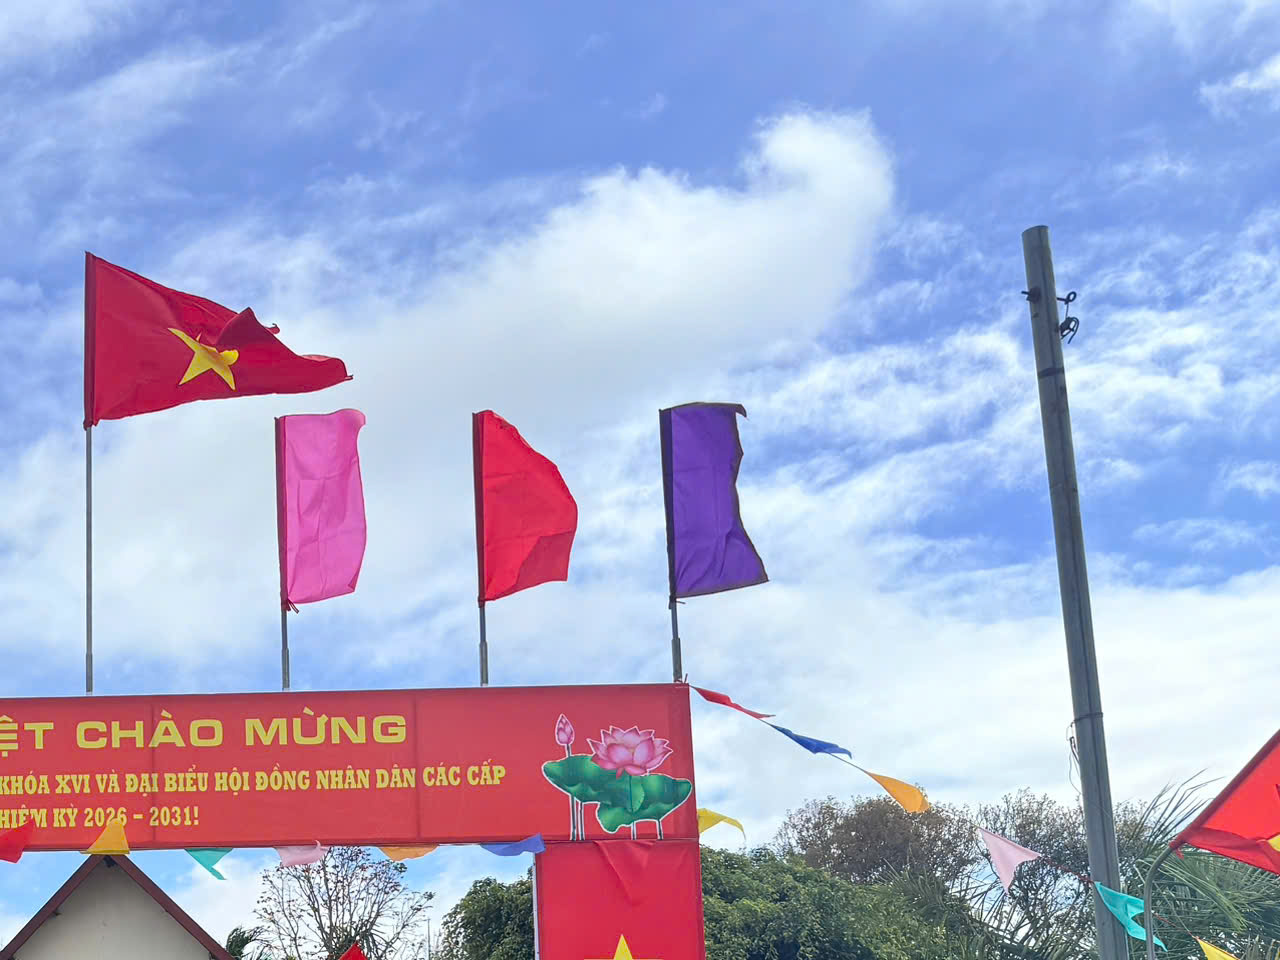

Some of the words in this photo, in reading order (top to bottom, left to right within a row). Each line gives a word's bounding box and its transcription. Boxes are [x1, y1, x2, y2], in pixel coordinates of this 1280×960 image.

[77, 710, 223, 748] CHÀO
[245, 707, 406, 746] MỪNG
[56, 775, 90, 794] XVI
[96, 770, 120, 792] VÀ
[125, 773, 158, 795] ĐẠI
[165, 765, 208, 792] BIỂU
[216, 768, 249, 795] HỘI
[256, 764, 310, 791] ĐỒNG
[316, 766, 370, 789] NHÂN
[376, 765, 416, 788] DÂN
[424, 763, 460, 786] CÁC
[467, 759, 506, 785] CẤP
[53, 803, 78, 827] KỲ
[84, 807, 127, 827] 2026
[149, 806, 199, 826] 2031!
